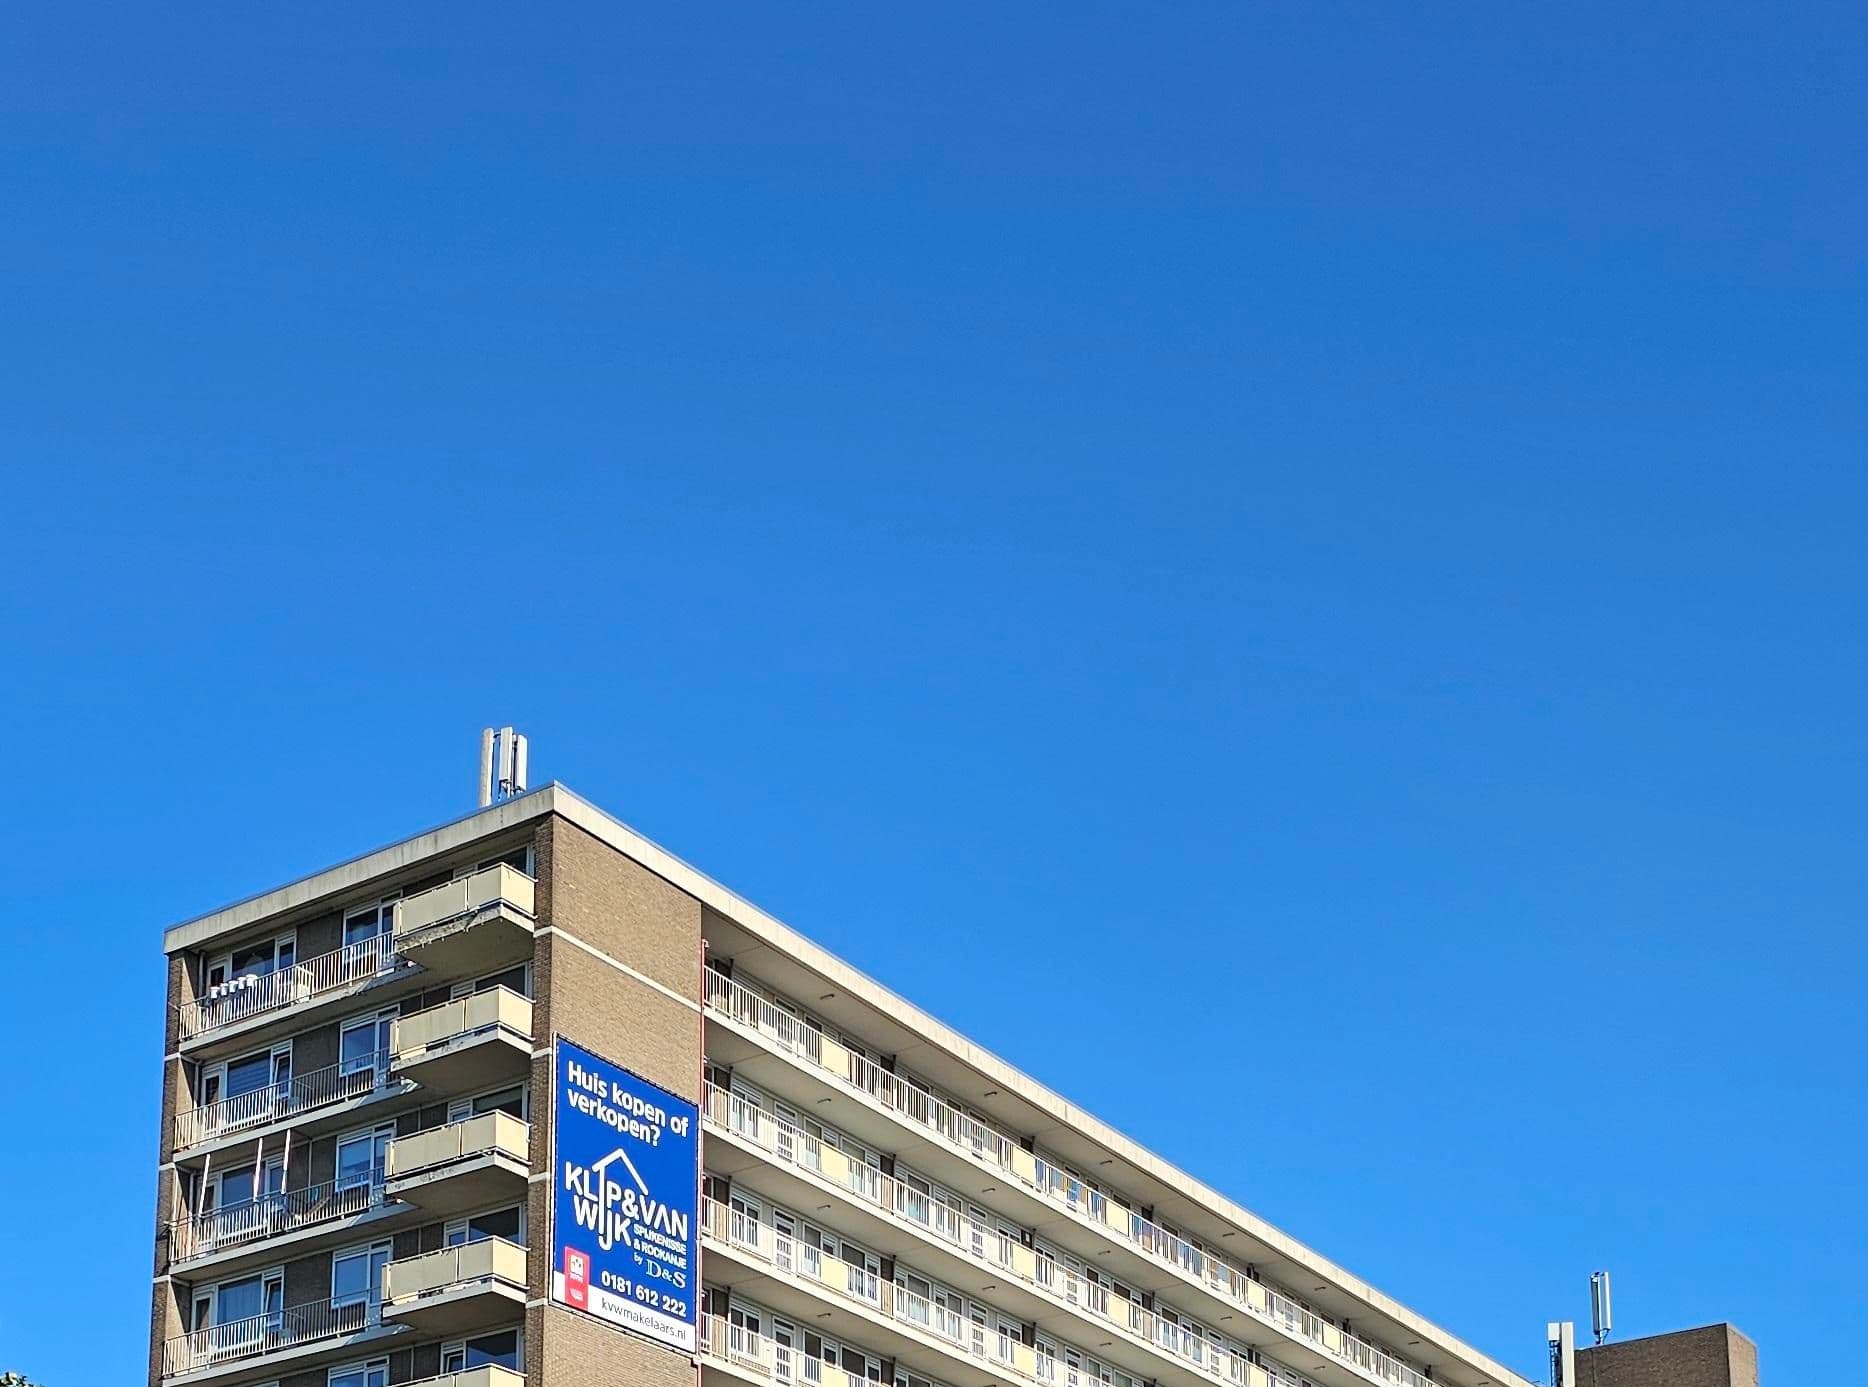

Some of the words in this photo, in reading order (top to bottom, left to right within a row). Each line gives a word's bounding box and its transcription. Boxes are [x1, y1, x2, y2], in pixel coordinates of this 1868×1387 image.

[567, 1088, 661, 1147] verkopen?
[568, 1060, 608, 1098] Huis
[612, 1082, 666, 1127] kopen
[670, 1116, 689, 1138] of
[601, 1270, 632, 1296] 0181
[635, 1284, 659, 1307] 612
[662, 1295, 687, 1318] 222
[601, 1297, 686, 1340] kvwmakelaars.nl
